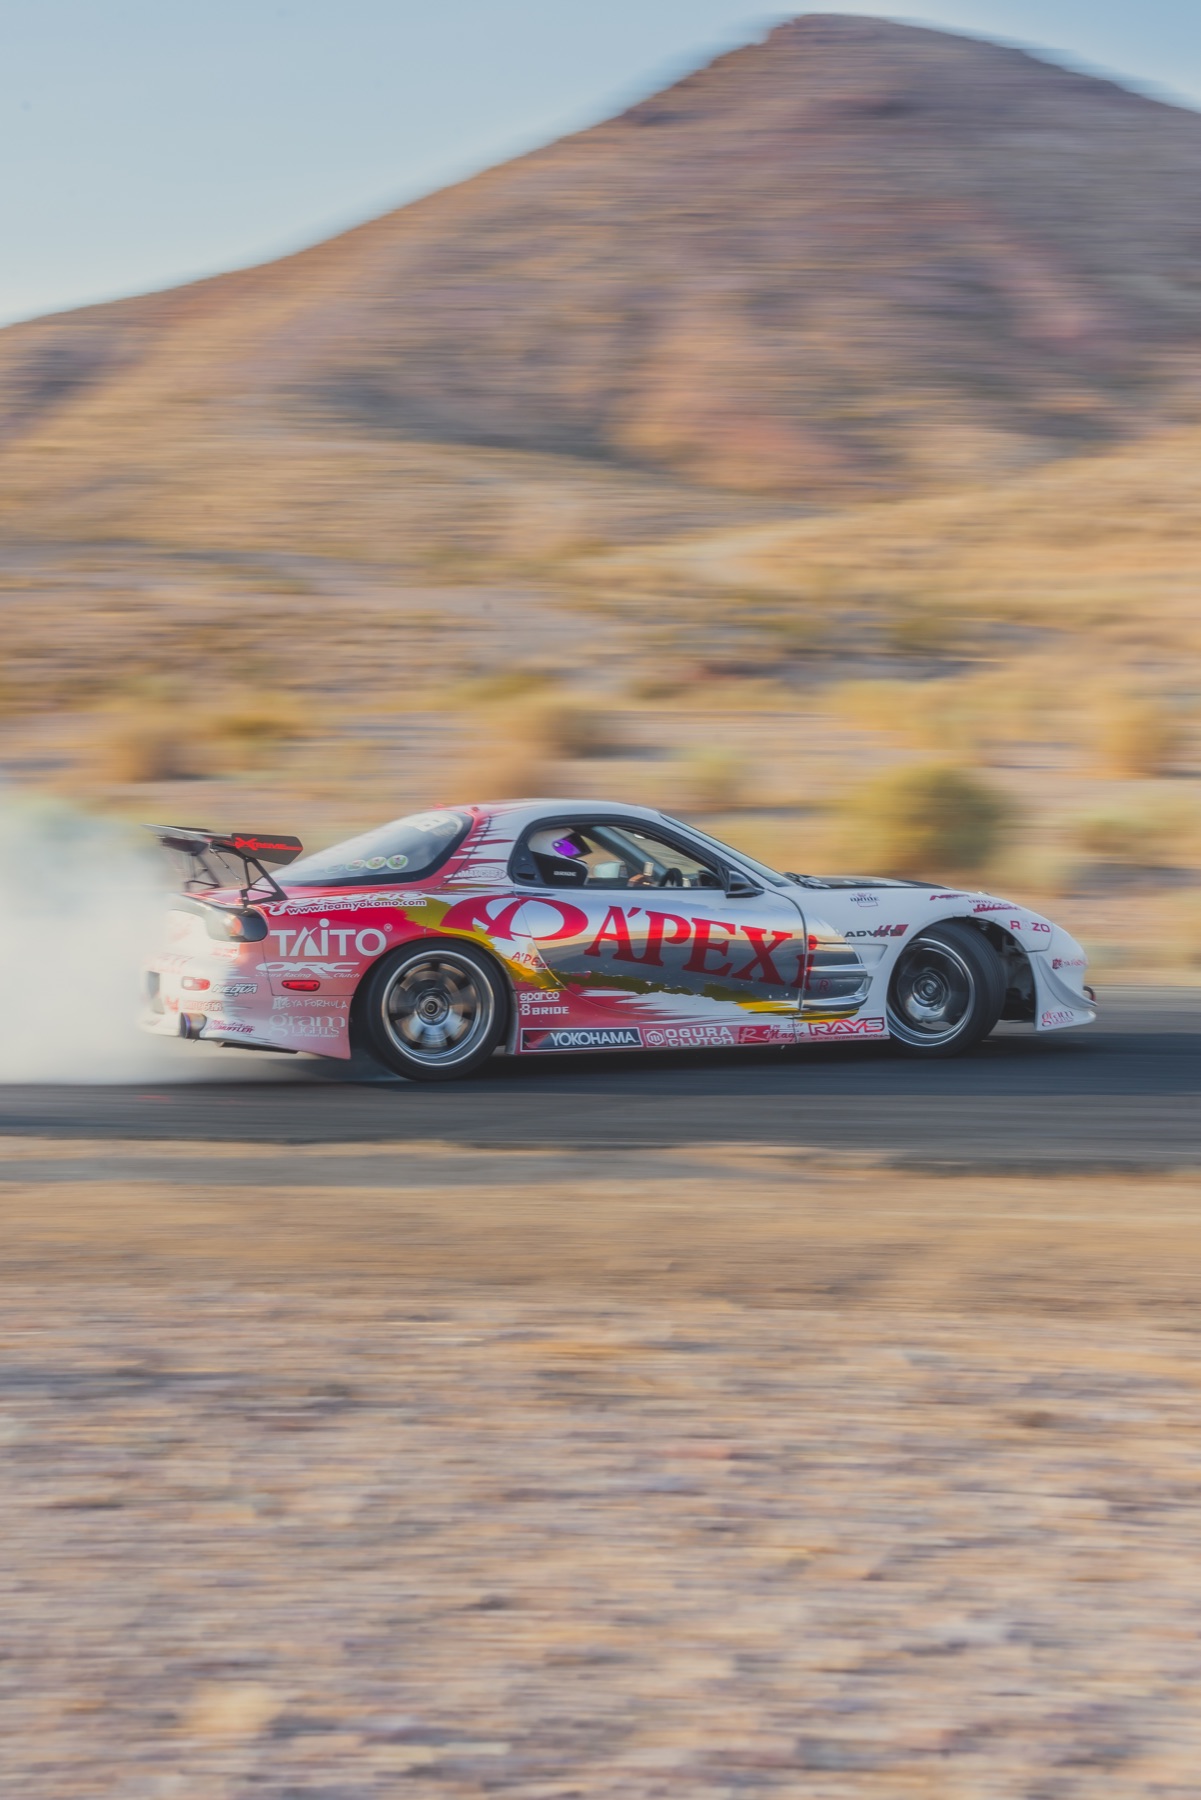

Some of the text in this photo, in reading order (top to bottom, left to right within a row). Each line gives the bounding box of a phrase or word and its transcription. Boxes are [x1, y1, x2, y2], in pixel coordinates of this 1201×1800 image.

[288, 900, 426, 914] www.teamyokomo.com
[1010, 920, 1050, 932] RZO
[519, 991, 560, 1002] sparco
[304, 999, 348, 1009] FORMULA
[532, 1006, 569, 1015] BRIDE
[808, 1017, 885, 1036] RAYS
[665, 1027, 731, 1038] OGURA
[551, 1031, 637, 1046] YOKOHAMA
[668, 1036, 734, 1047] CLUTCH
